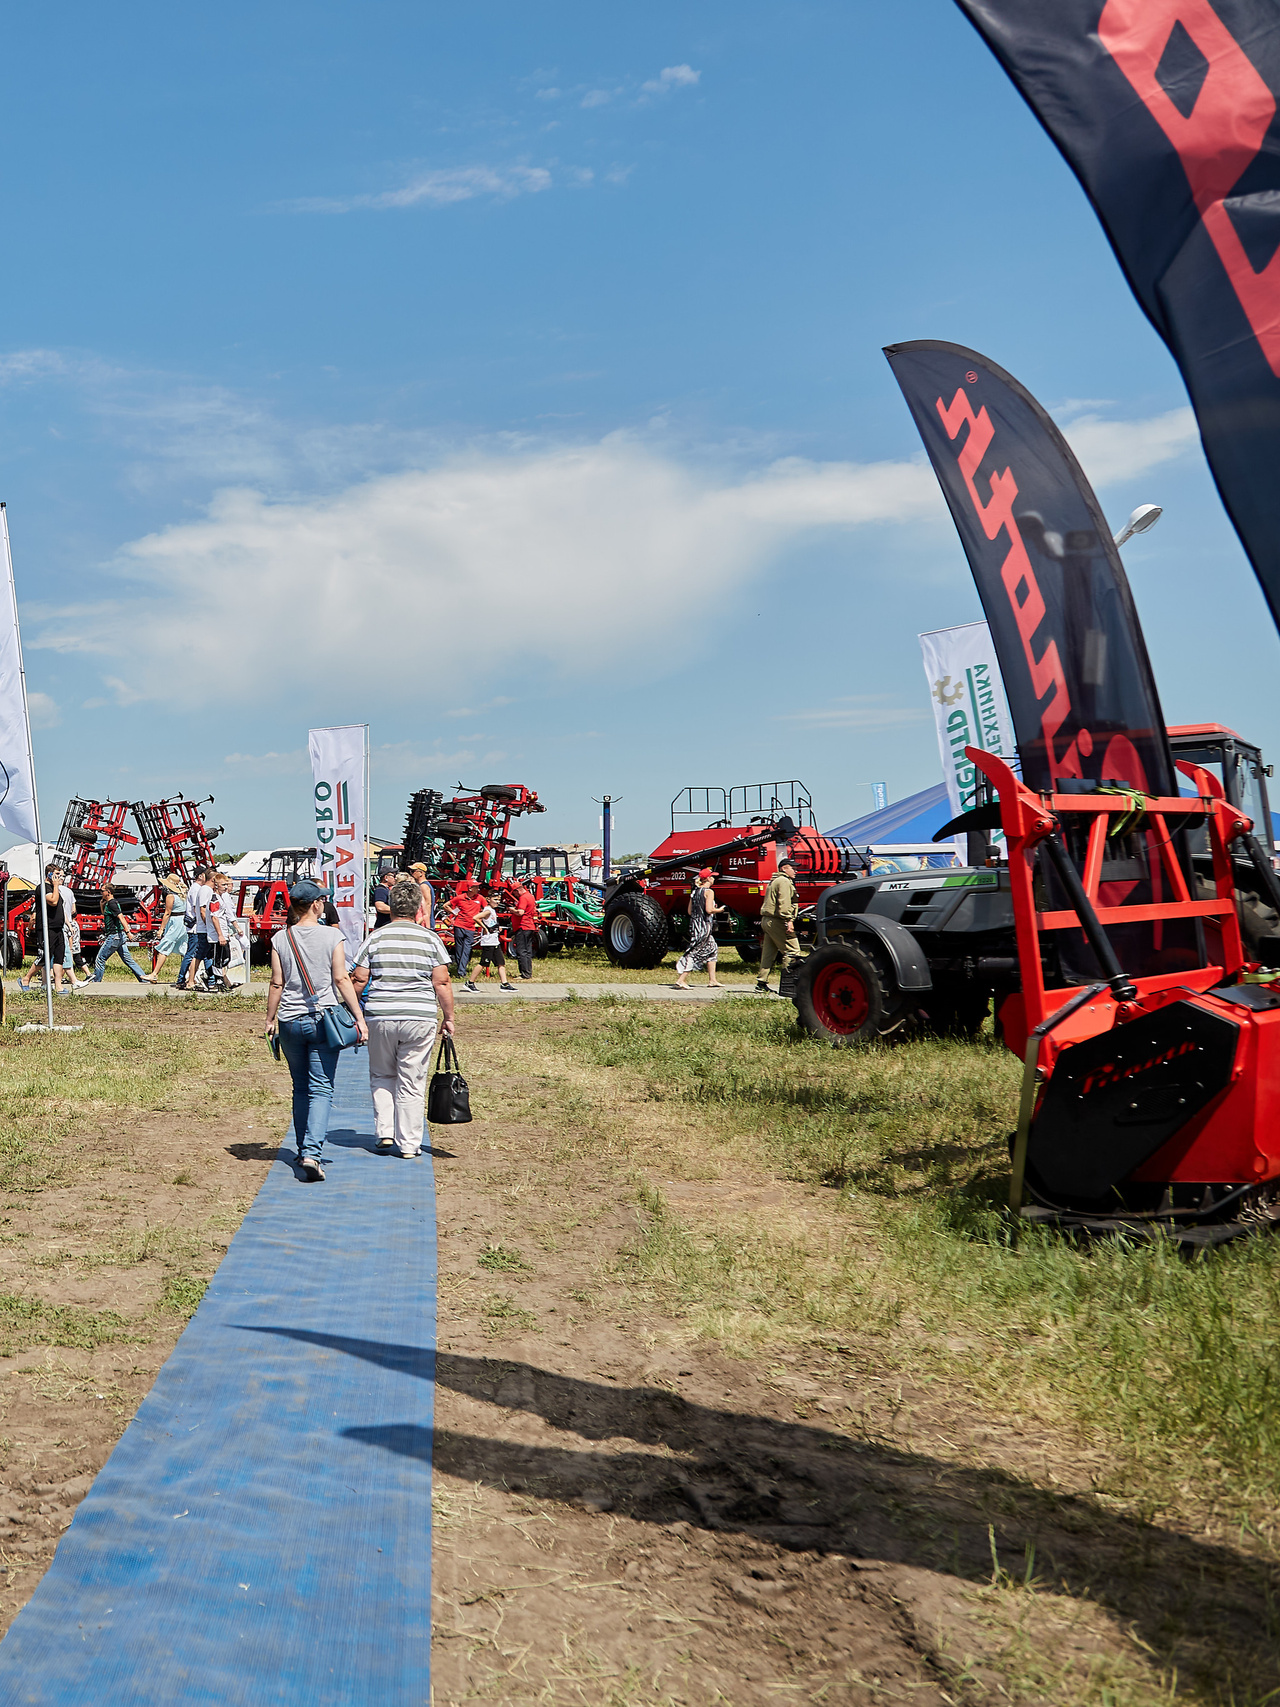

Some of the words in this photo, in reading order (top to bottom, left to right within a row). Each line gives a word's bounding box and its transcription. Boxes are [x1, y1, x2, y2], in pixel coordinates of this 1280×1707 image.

[729, 857, 747, 866] FEAT
[671, 871, 686, 881] 2023
[888, 882, 910, 890] MTZ
